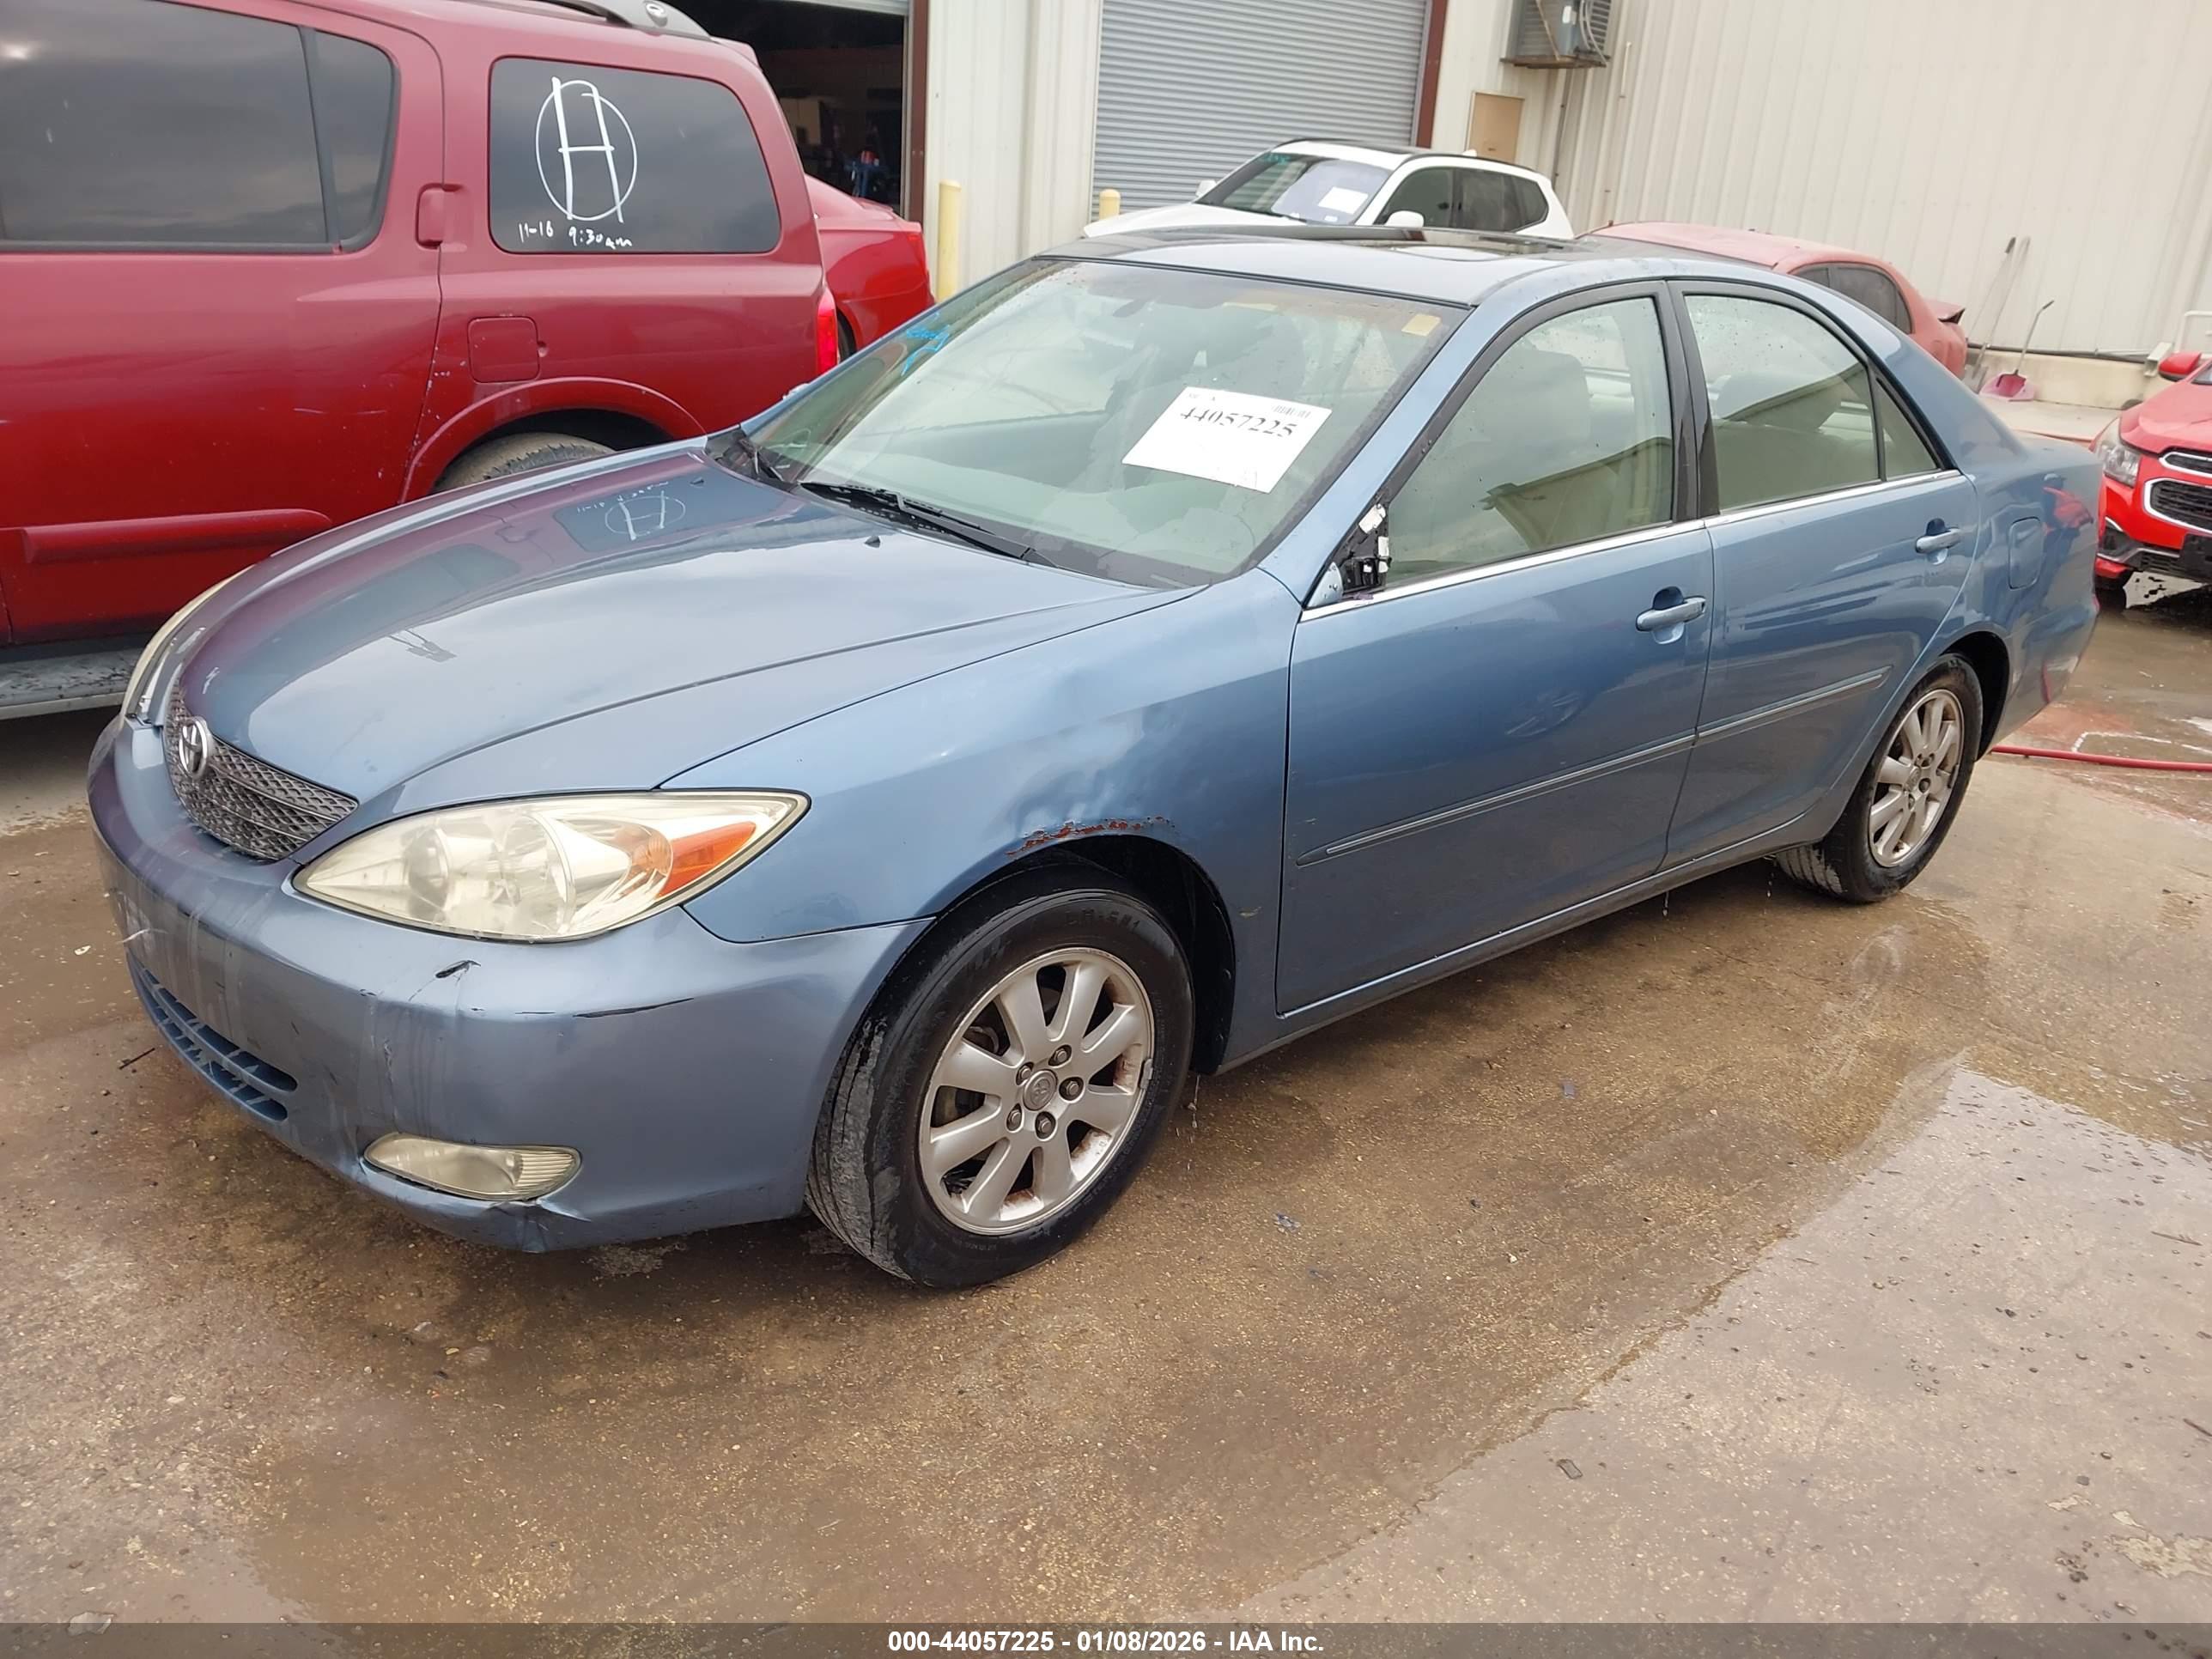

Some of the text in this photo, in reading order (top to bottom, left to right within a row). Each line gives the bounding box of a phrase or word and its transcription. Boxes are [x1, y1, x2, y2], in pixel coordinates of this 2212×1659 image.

[551, 76, 624, 223] H
[518, 220, 554, 243] 11-16
[1180, 407, 1297, 437] 44057225
